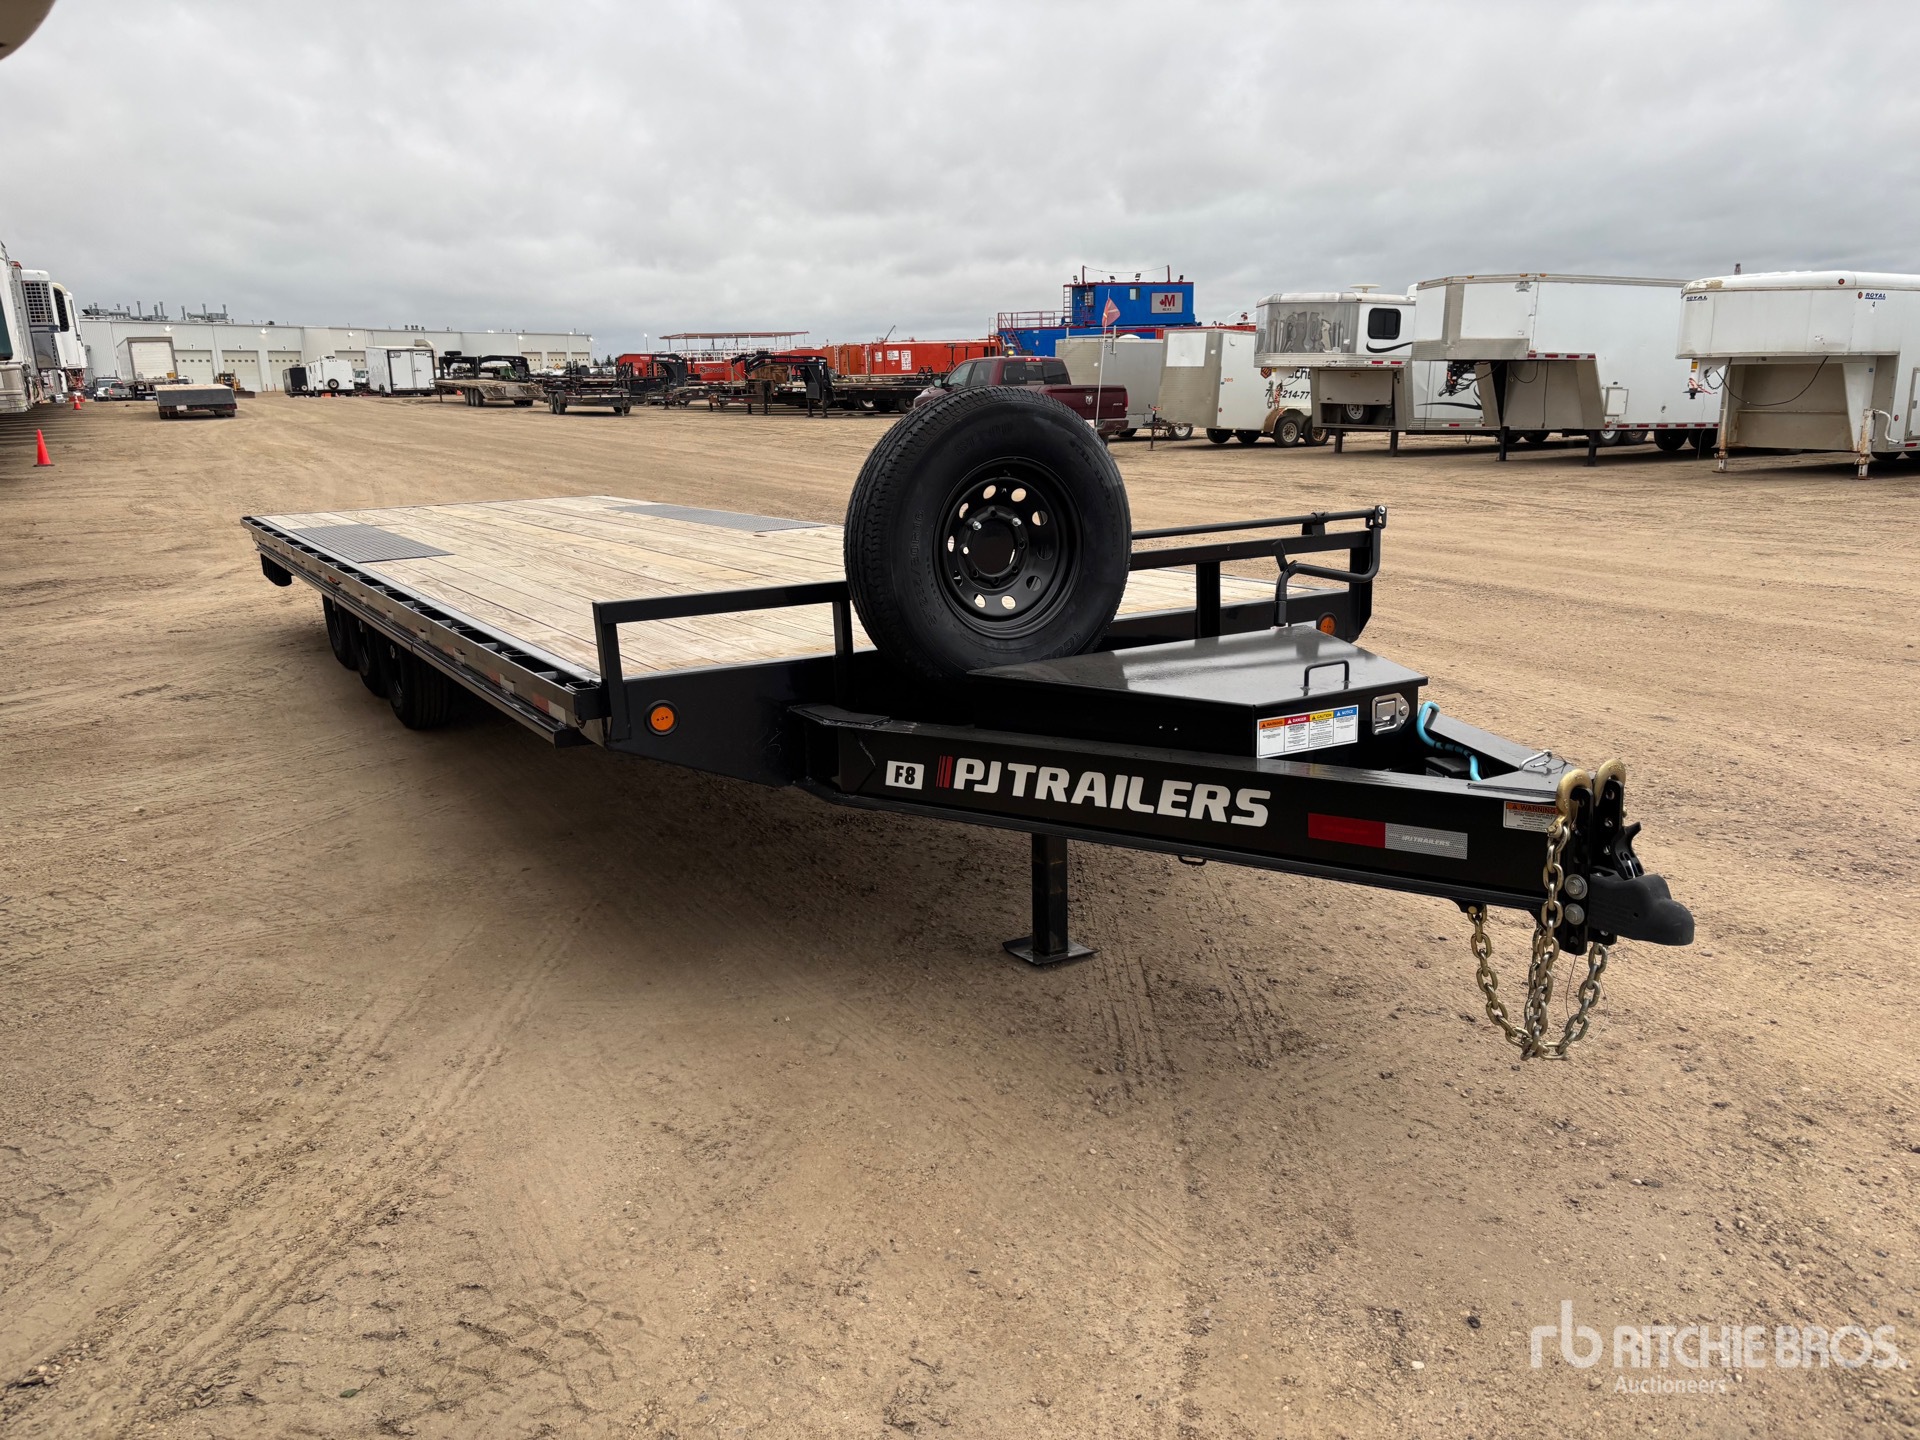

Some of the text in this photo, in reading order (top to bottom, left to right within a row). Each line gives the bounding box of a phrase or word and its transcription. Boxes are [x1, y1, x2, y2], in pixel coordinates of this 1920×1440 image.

[893, 764, 916, 786] F8
[1007, 762, 1271, 828] TRAILERS
[1520, 804, 1558, 815] WARNING
